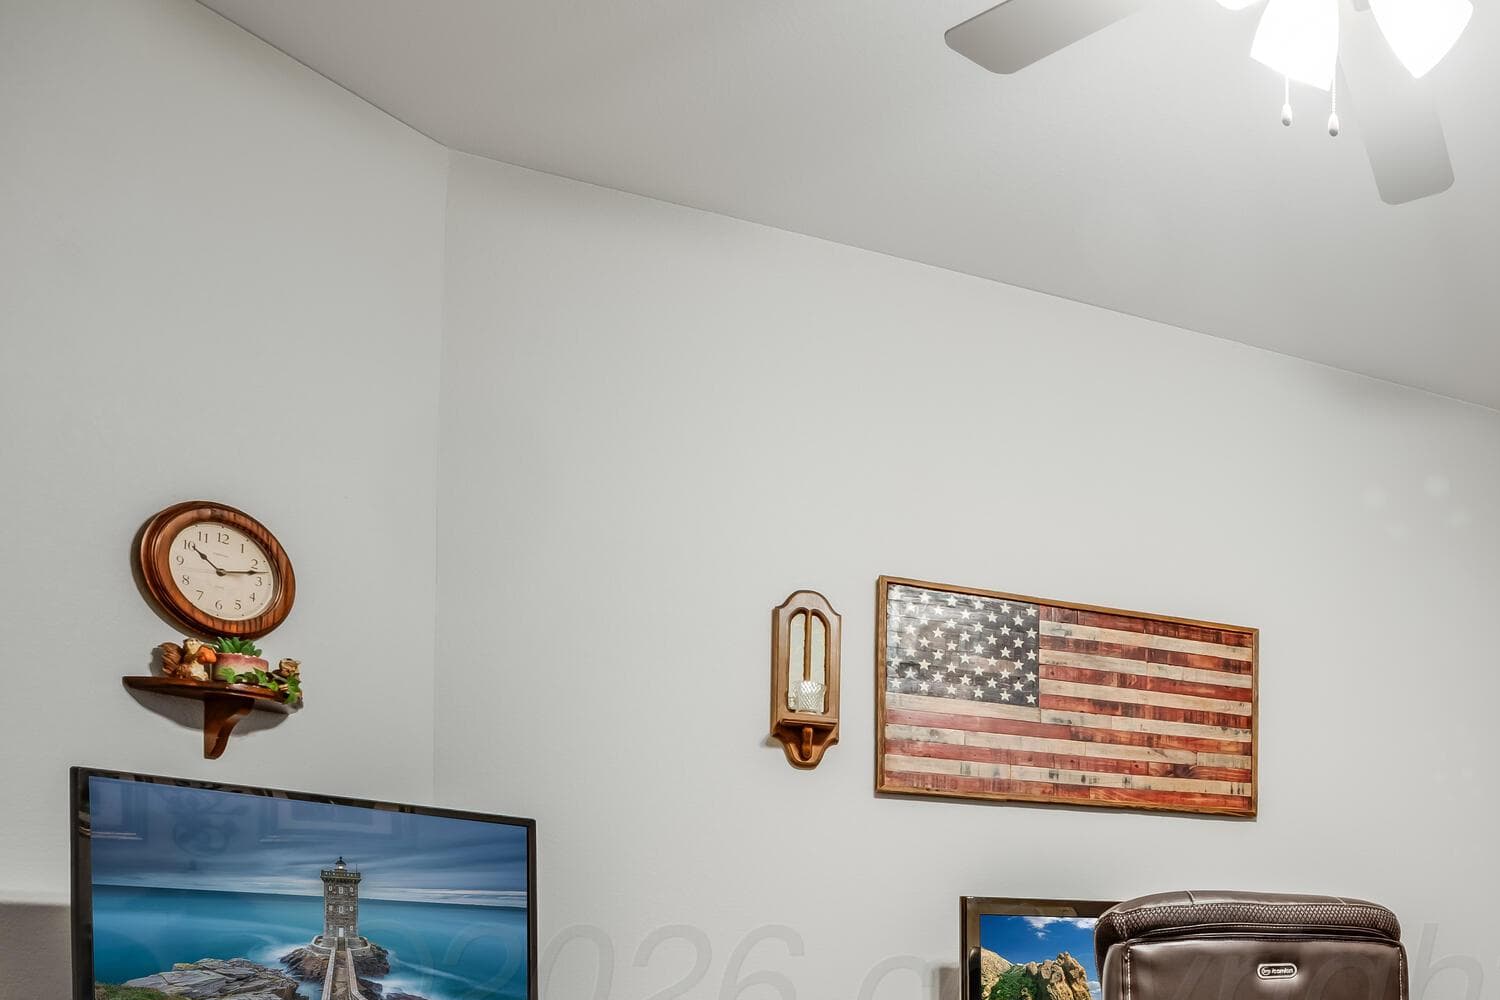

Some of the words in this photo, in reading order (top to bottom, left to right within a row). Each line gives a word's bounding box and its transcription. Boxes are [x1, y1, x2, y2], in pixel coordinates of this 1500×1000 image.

[198, 531, 209, 544] 11
[217, 532, 230, 545] 12
[183, 539, 196, 550] 10
[240, 543, 245, 554] 1
[175, 555, 185, 566] 9
[250, 558, 259, 570] 2
[182, 574, 190, 586] 8
[254, 576, 263, 587] 3
[195, 589, 204, 601] 7
[248, 592, 256, 603] 4
[215, 600, 223, 611] 6
[233, 600, 242, 611] 5
